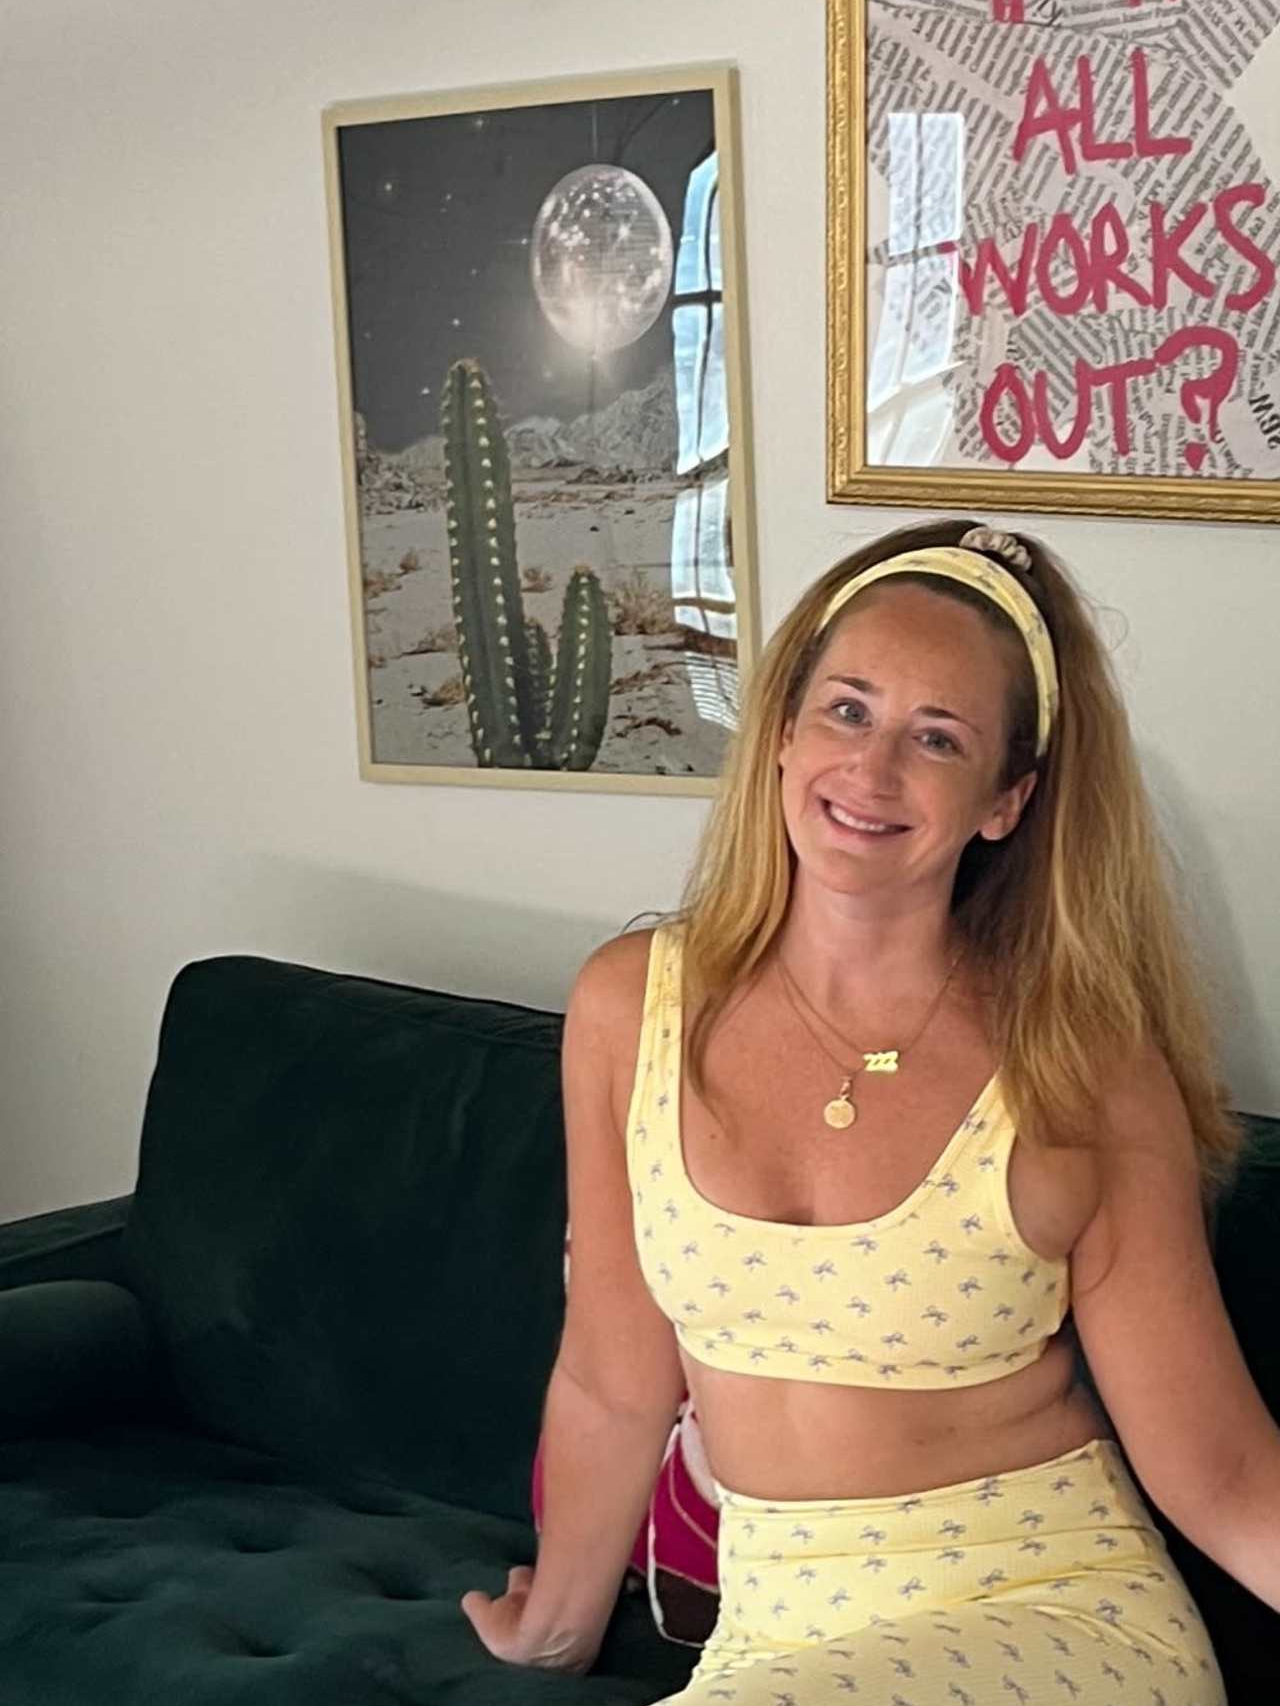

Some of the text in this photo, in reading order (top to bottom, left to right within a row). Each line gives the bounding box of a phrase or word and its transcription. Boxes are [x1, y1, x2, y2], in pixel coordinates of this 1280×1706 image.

[1013, 47, 1192, 175] ALL
[936, 183, 1276, 317] WORKS
[979, 326, 1239, 471] OUT?
